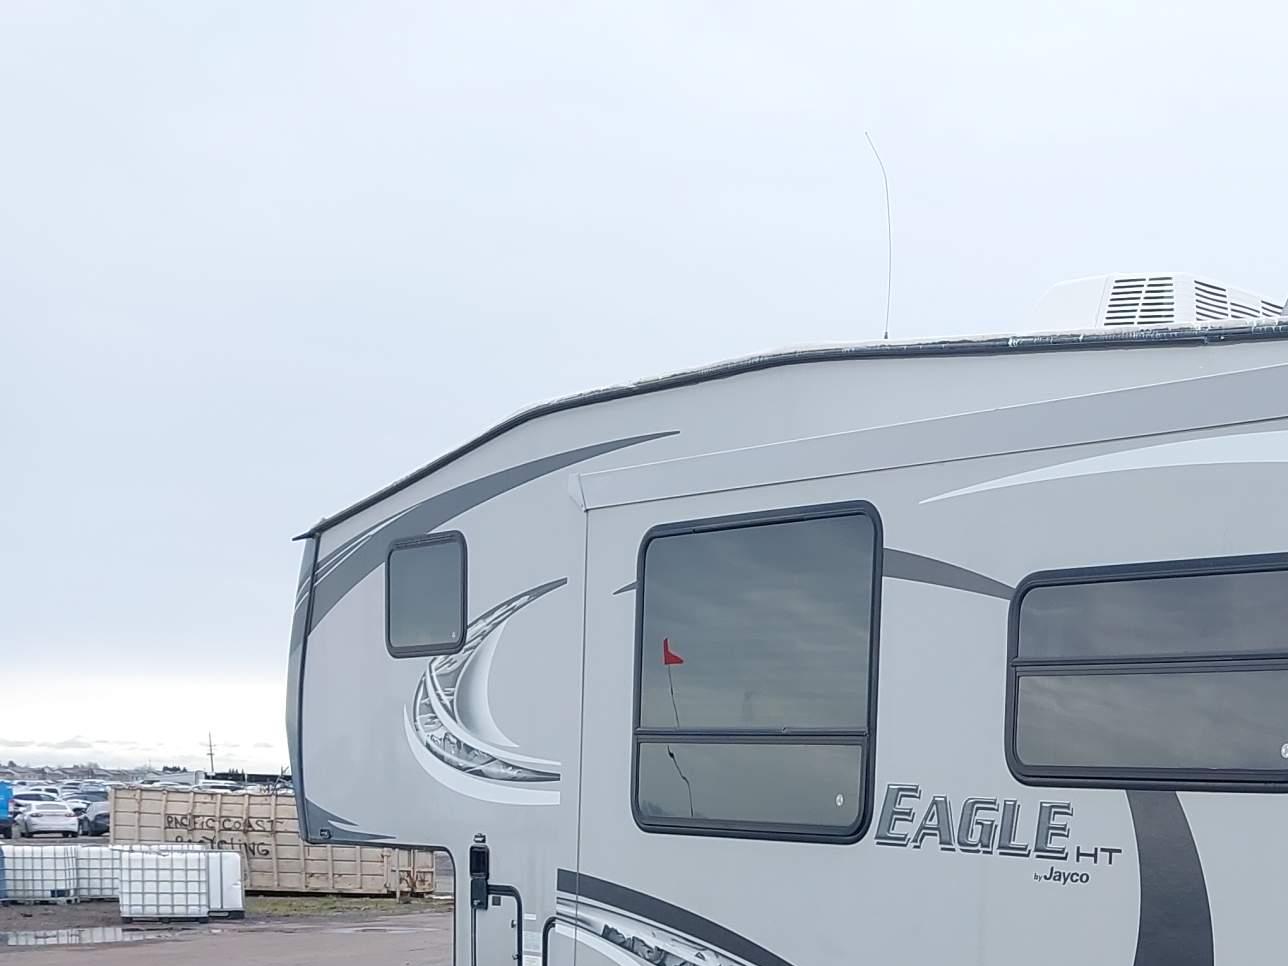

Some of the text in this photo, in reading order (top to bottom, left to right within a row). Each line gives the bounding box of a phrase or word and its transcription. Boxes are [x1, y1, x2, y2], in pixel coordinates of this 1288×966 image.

[875, 783, 1122, 865] EAGLE HT
[1033, 866, 1089, 884] by Jayco
